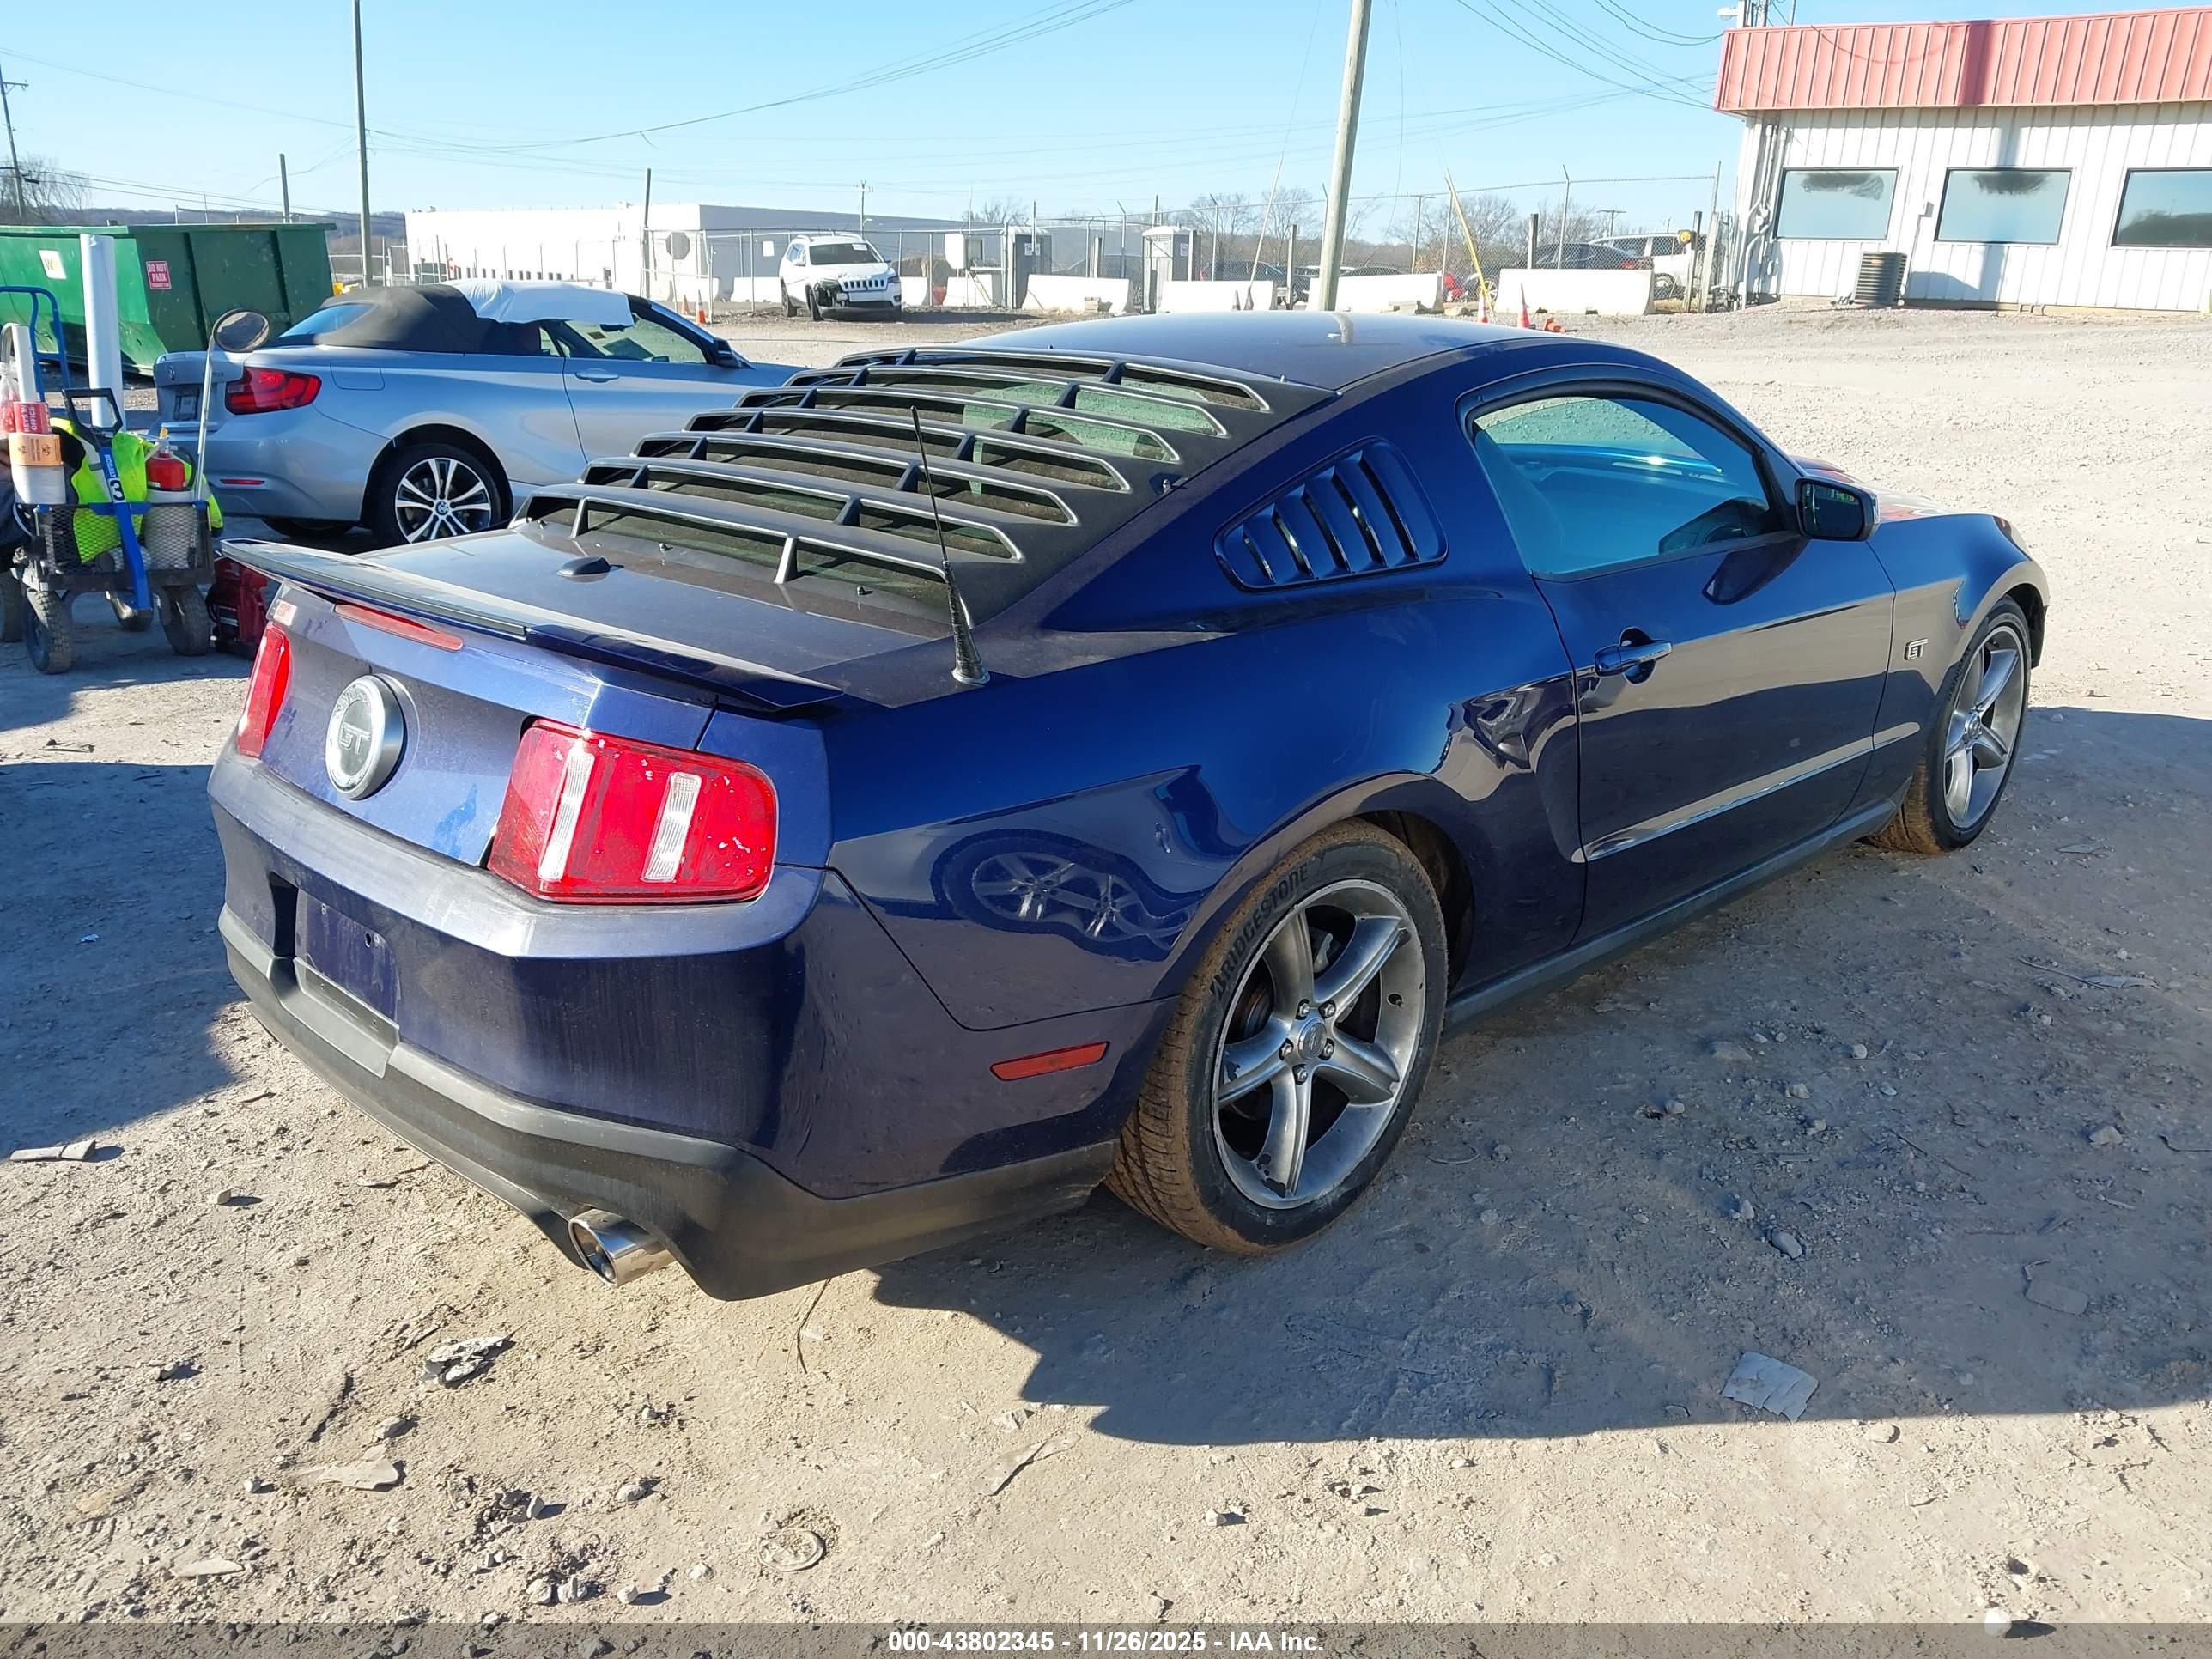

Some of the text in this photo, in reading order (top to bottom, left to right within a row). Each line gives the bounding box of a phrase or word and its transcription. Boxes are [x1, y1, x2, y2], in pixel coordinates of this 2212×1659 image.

[147, 263, 166, 272] DO NOT
[151, 272, 167, 282] PARK
[21, 404, 30, 432] KEYS IN
[110, 480, 125, 501] 3
[1904, 638, 1929, 660] GT
[339, 721, 371, 755] GT
[1209, 863, 1308, 1001] BRIDGESTONE
